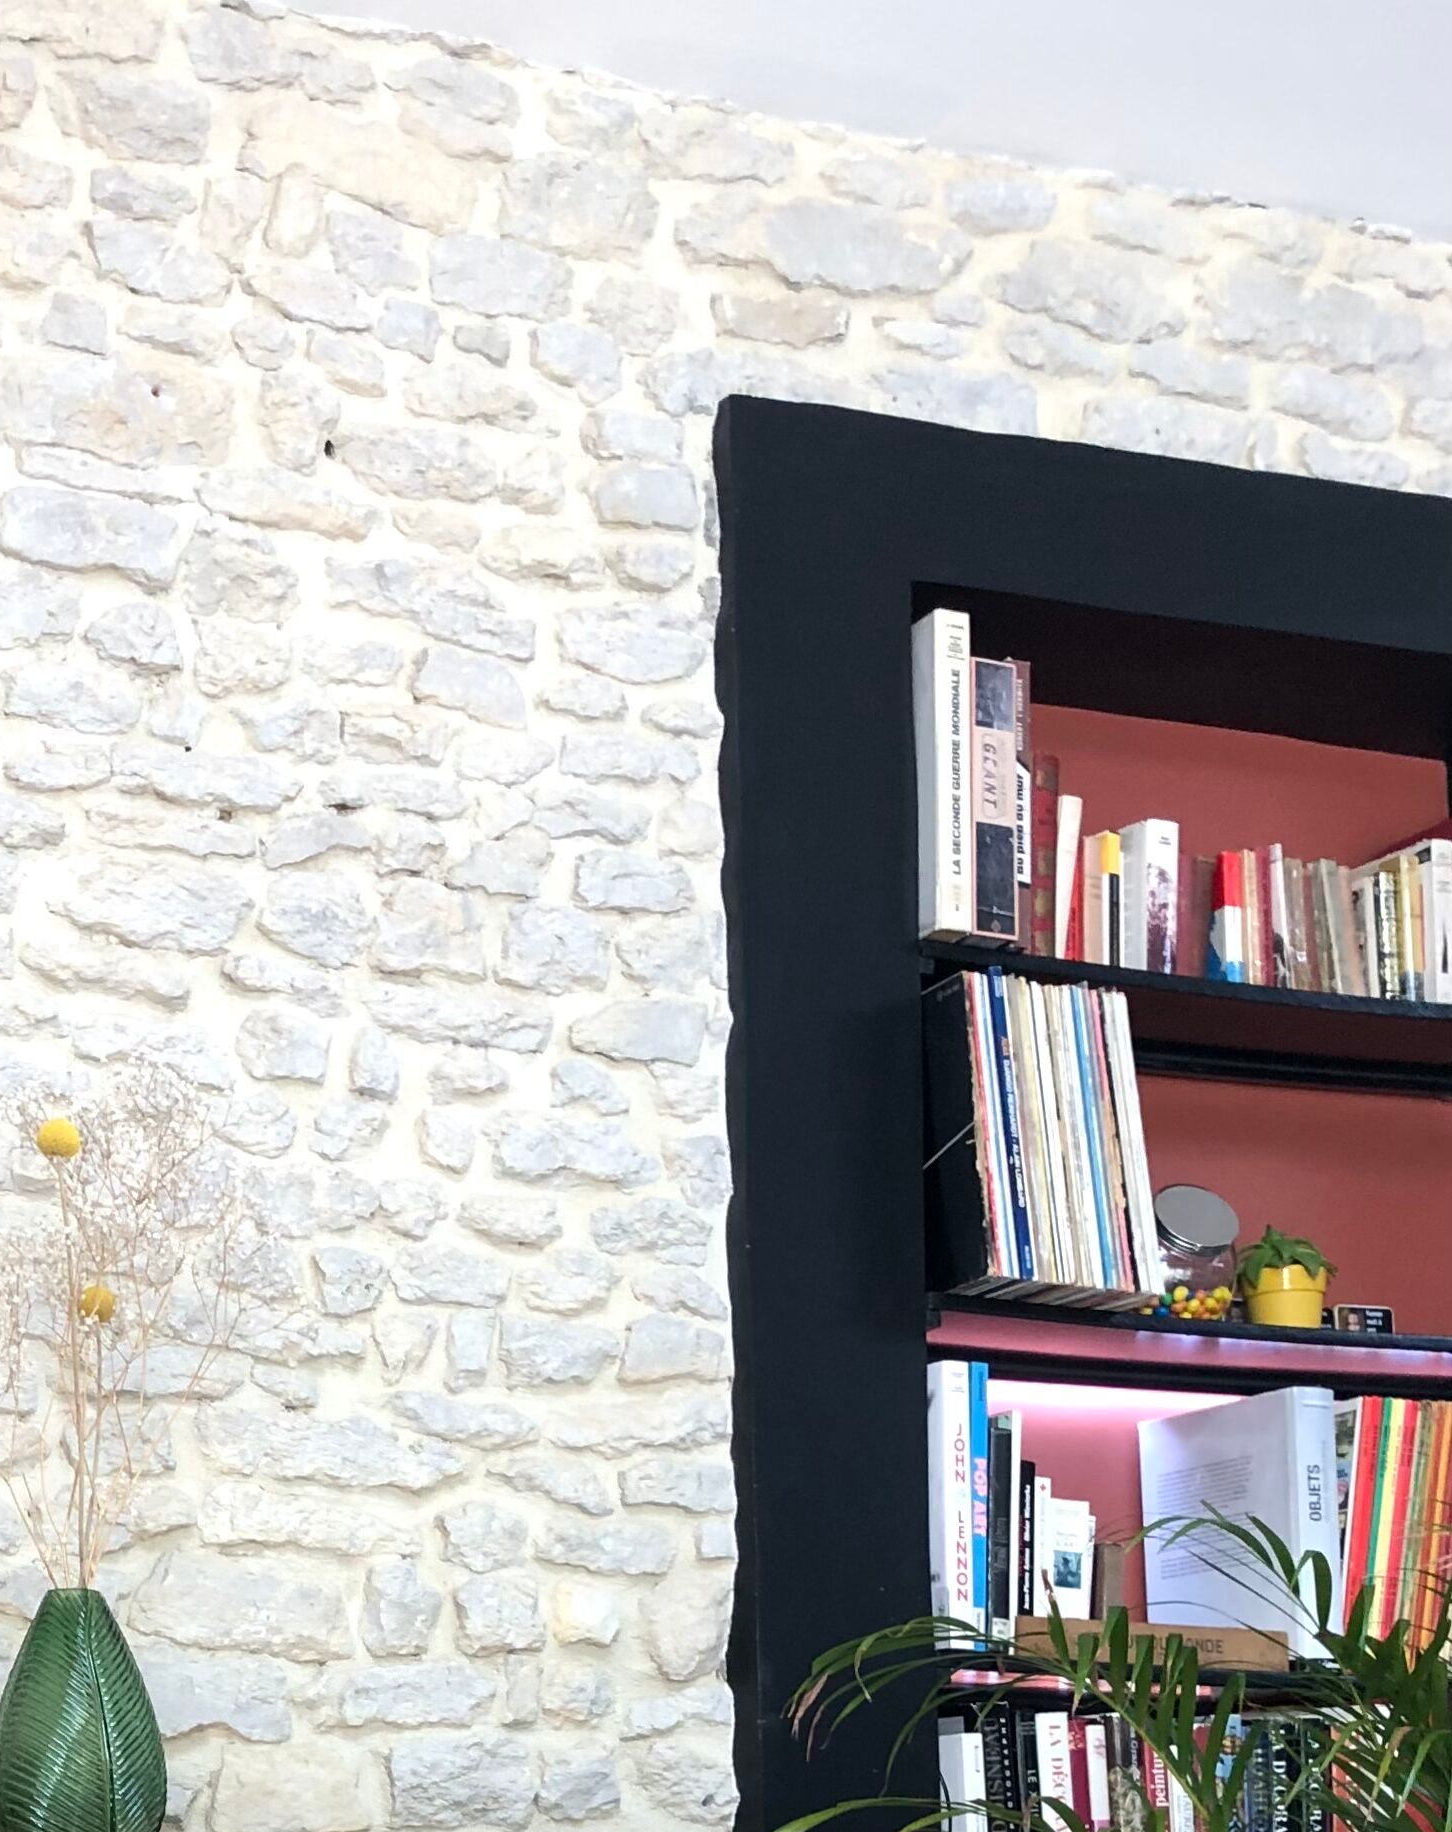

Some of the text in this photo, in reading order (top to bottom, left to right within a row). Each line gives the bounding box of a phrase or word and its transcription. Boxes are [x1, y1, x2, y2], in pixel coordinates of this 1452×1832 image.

[951, 668, 961, 736] MONDIALE
[951, 739, 961, 791] GUERRE
[952, 793, 961, 856] SECONDE
[952, 859, 961, 875] LA
[954, 1423, 969, 1602] JOHN LENNON
[973, 1457, 988, 1536] POP ART
[1306, 1463, 1323, 1522] OBJETS
[1049, 1724, 1062, 1747] LA
